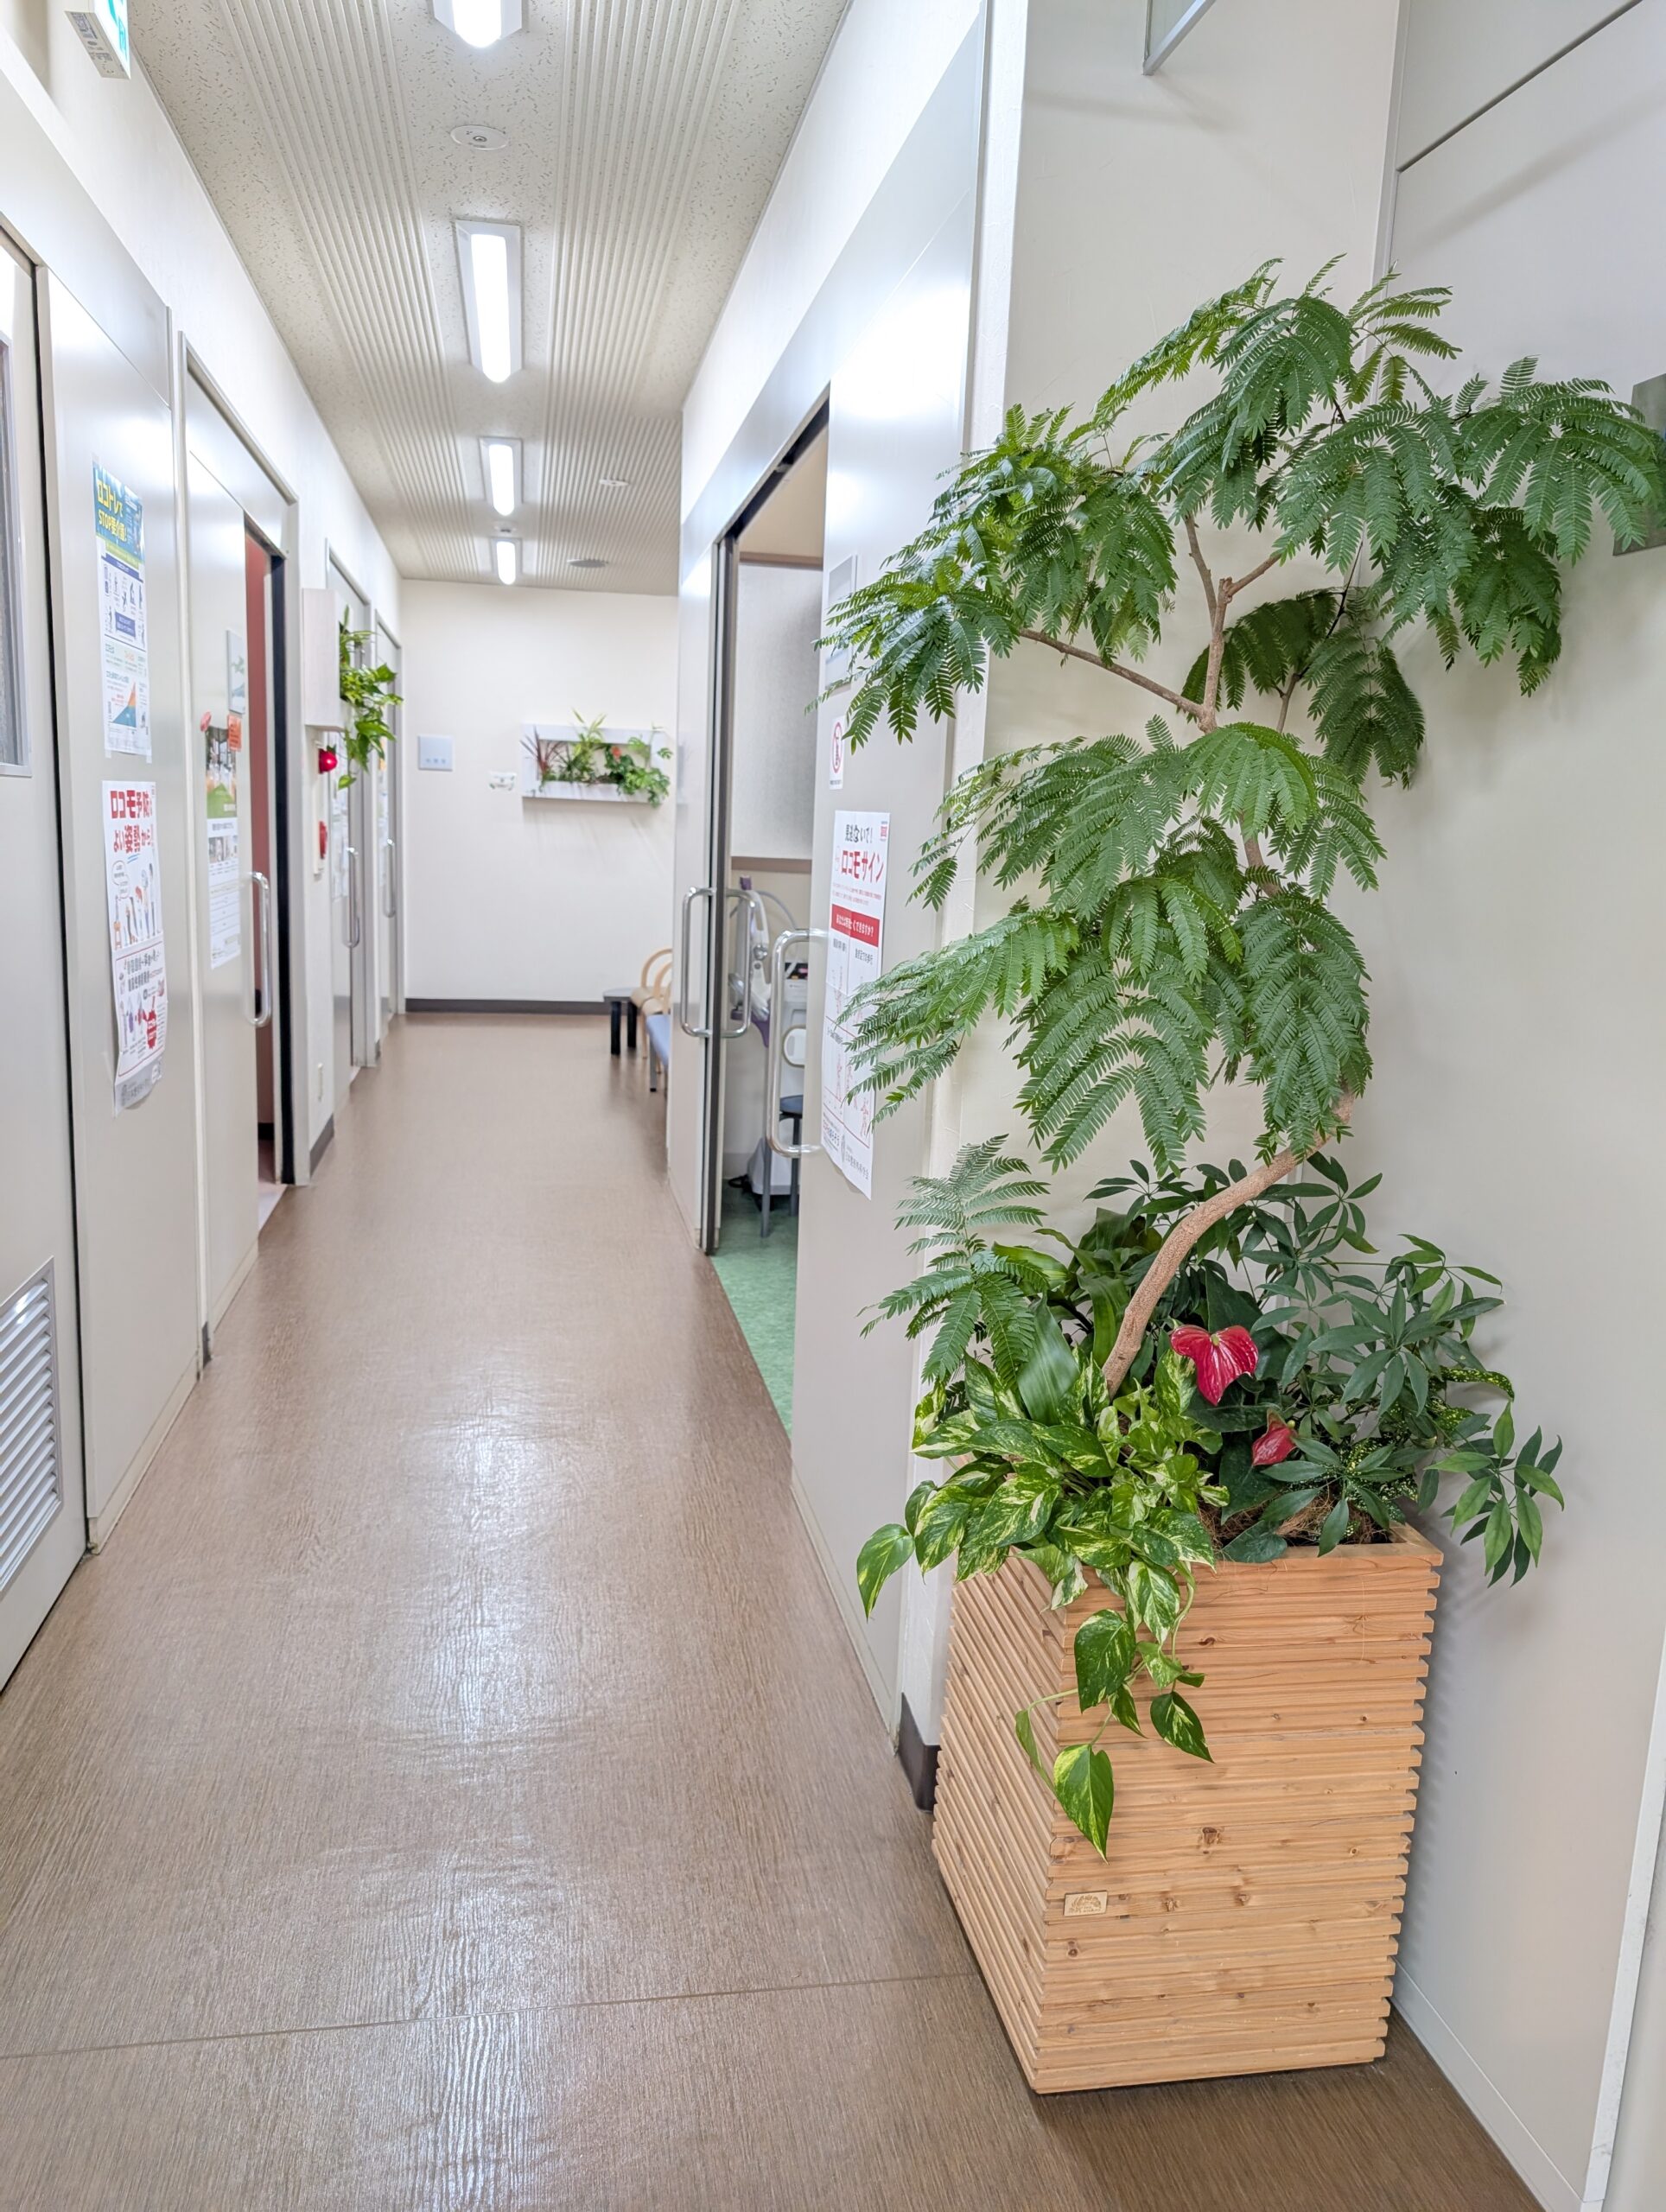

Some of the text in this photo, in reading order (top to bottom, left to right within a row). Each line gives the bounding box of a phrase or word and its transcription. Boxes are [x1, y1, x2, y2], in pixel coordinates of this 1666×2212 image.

[842, 850, 884, 880] ロコモサイン
